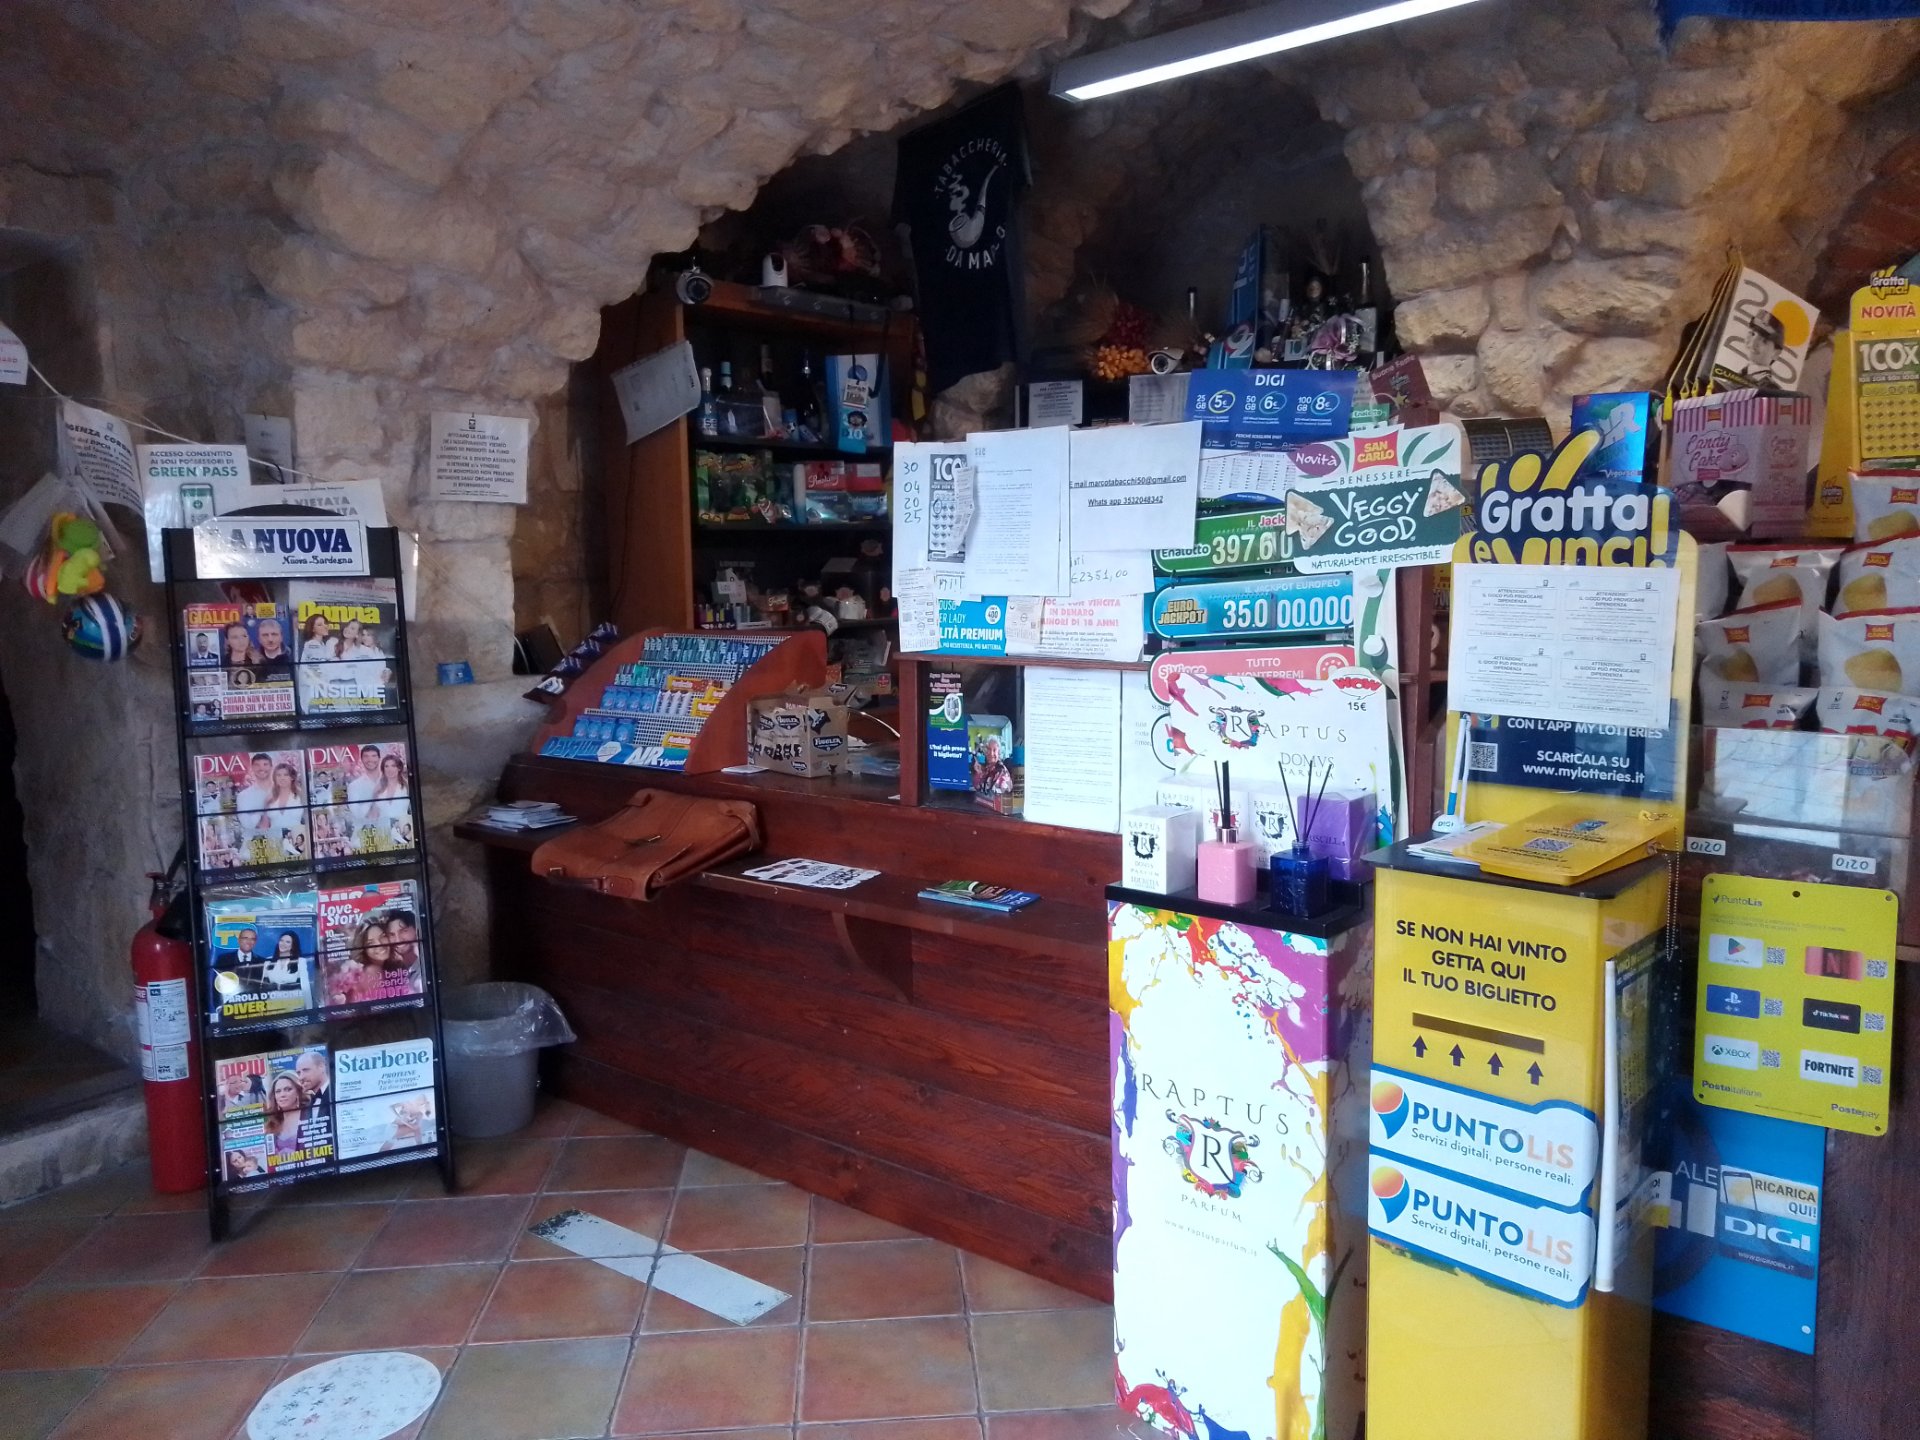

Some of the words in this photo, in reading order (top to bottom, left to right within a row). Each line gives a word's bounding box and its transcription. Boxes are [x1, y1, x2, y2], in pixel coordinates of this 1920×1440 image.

[934, 138, 1007, 193] TABACCHERIA
[946, 244, 963, 267] DA
[1860, 302, 1916, 319] NOVITÀ
[1254, 374, 1286, 387] DIGI
[1195, 402, 1207, 410] GB
[1196, 394, 1206, 402] 25
[1244, 403, 1256, 411] GB
[1245, 395, 1256, 403] 50
[1298, 396, 1312, 404] 100
[1296, 404, 1308, 412] GB
[1364, 440, 1389, 452] SAN
[1685, 434, 1731, 456] Candy
[150, 450, 184, 459] ACCESSO
[186, 450, 233, 459] CONSENTITO
[1295, 451, 1338, 467] Novità
[1356, 448, 1395, 464] CARLO
[1688, 449, 1723, 471] Cake
[149, 467, 200, 478] GREEN
[202, 466, 239, 478] PASS
[903, 461, 919, 475] 30
[1339, 468, 1411, 486] BENESSERE
[903, 480, 920, 494] 04
[903, 498, 920, 510] 20
[1088, 498, 1108, 507] Whats
[1109, 498, 1122, 507] app
[1329, 486, 1423, 521] VEGGY
[1480, 484, 1649, 534] Gratta
[903, 509, 923, 524] 25
[1334, 515, 1417, 547] GOOD
[253, 527, 354, 554] NUOVA
[1310, 555, 1377, 570] NATURALMENTE
[1378, 549, 1442, 563] IRRESISTIBILE
[1474, 539, 1493, 564] e
[281, 557, 309, 570] Nuova
[309, 557, 353, 570] Sardegna
[1295, 580, 1341, 590] EUROPEO
[1088, 598, 1121, 607] VINCITA
[188, 608, 242, 626] GIALLO
[298, 601, 382, 625] Donna
[948, 613, 966, 624] LADY
[1060, 609, 1095, 617] DENARO
[1158, 609, 1205, 625] JACKPOT
[959, 627, 1003, 641] PREMIUM
[1246, 658, 1281, 668] TUTTO
[1332, 677, 1382, 691] WOW
[1347, 702, 1367, 712] 15€
[1506, 717, 1534, 729] CON
[1537, 719, 1571, 732] L'APP
[1574, 722, 1593, 734] MY
[1598, 725, 1663, 739] LOTTERIES
[200, 755, 247, 775] DIVA
[310, 746, 355, 766] DIVA
[623, 746, 664, 766] AIR
[1536, 750, 1607, 766] SCARICALA
[1611, 756, 1630, 769] SU
[1522, 764, 1645, 784] www.mylotteries.it
[320, 903, 353, 918] Love
[326, 912, 363, 927] Story
[1395, 919, 1416, 937] SE
[1420, 923, 1464, 946] NON
[1469, 931, 1503, 953] HAI
[1506, 938, 1568, 964] VINTO
[1430, 949, 1486, 975] GETTA
[1490, 960, 1526, 982] QUI
[1402, 966, 1417, 985] IL
[1420, 969, 1459, 993] TUO
[1464, 978, 1557, 1012] BIGLIETTO
[338, 1049, 431, 1075] Starbene
[1724, 1046, 1751, 1060] XBOX
[1804, 1058, 1854, 1079] FORTNITE
[1140, 1071, 1289, 1136] RAPTUS
[1830, 1103, 1880, 1121] Postepay
[1412, 1101, 1575, 1170] PUNTOLIS
[267, 1148, 303, 1167] WILLIAM
[303, 1148, 310, 1159] E
[312, 1144, 334, 1158] KATE
[1201, 1133, 1238, 1186] R
[1411, 1126, 1448, 1149] Servizi
[1450, 1138, 1492, 1163] digitali,
[1494, 1154, 1542, 1177] persone
[1544, 1170, 1574, 1187] reali.
[1754, 1178, 1817, 1204] RICARICA
[1180, 1193, 1242, 1223] PARFUM
[1788, 1200, 1818, 1219] QUI!
[1412, 1187, 1574, 1267] PUNTOLIS
[1724, 1214, 1811, 1252] DIGI
[1411, 1213, 1448, 1236] Servizi
[1450, 1226, 1492, 1254] digitali,
[1493, 1245, 1541, 1270] persone
[1542, 1264, 1573, 1283] reali.
